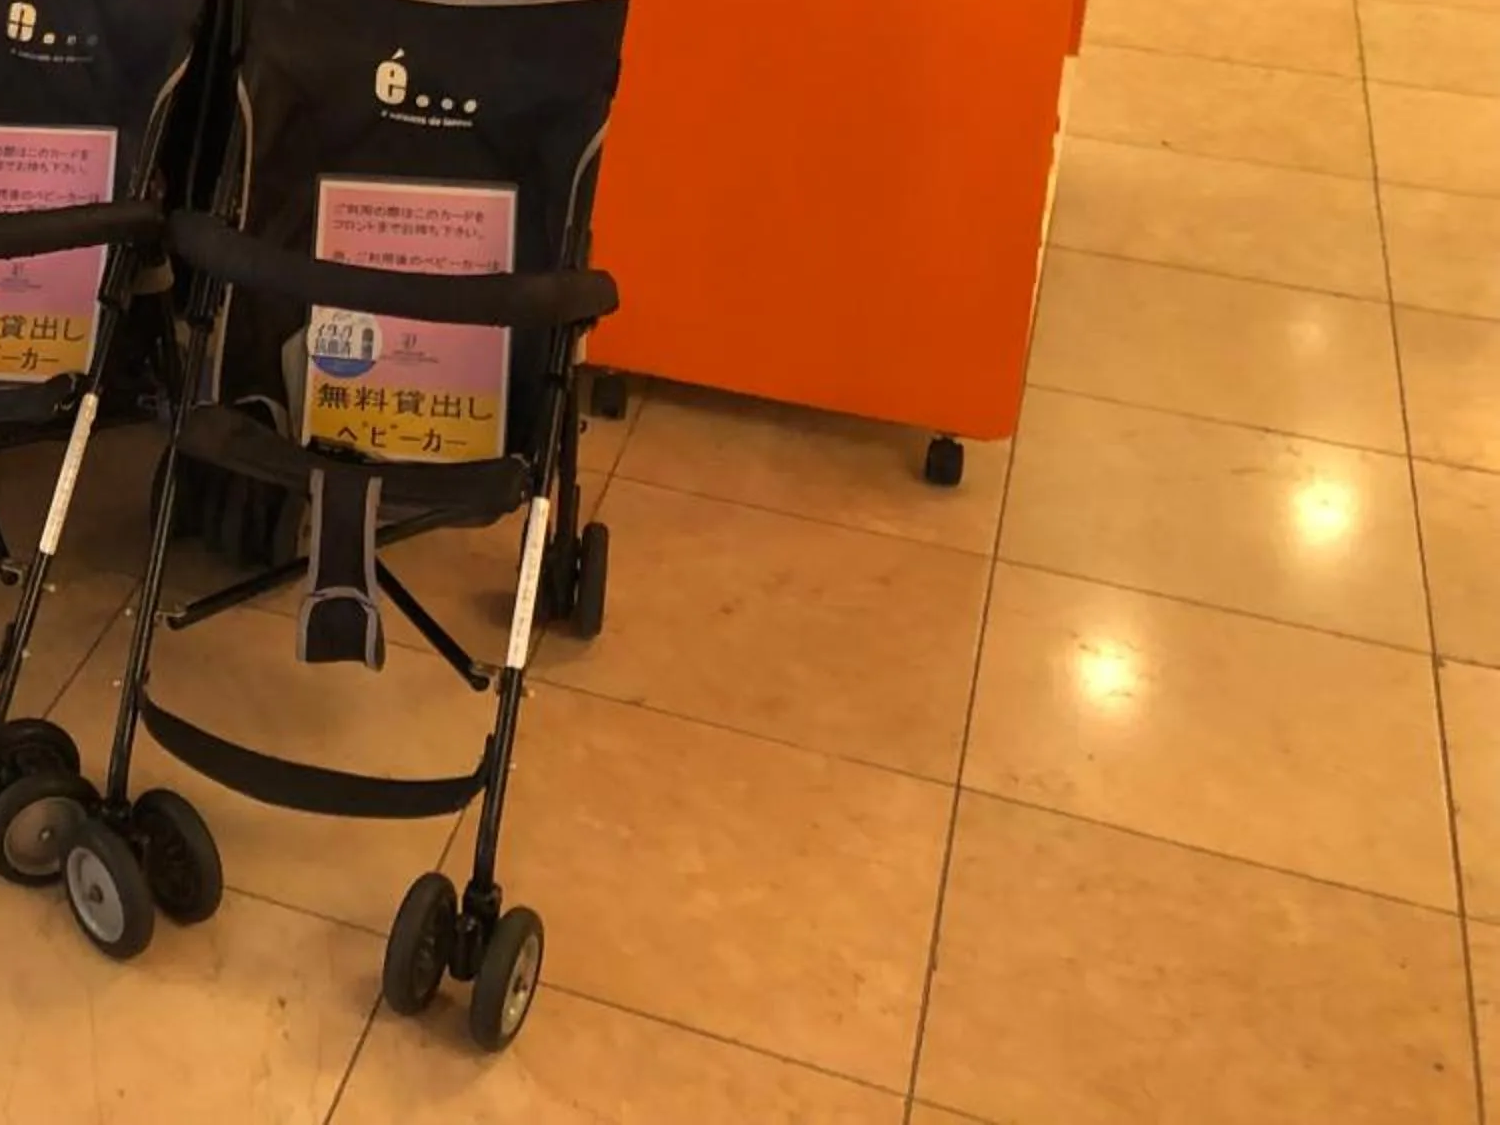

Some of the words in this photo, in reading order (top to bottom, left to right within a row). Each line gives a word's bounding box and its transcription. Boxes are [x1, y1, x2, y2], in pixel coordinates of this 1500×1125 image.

[317, 382, 494, 422] 無料貸出し
[336, 420, 468, 453] ベビーカー
